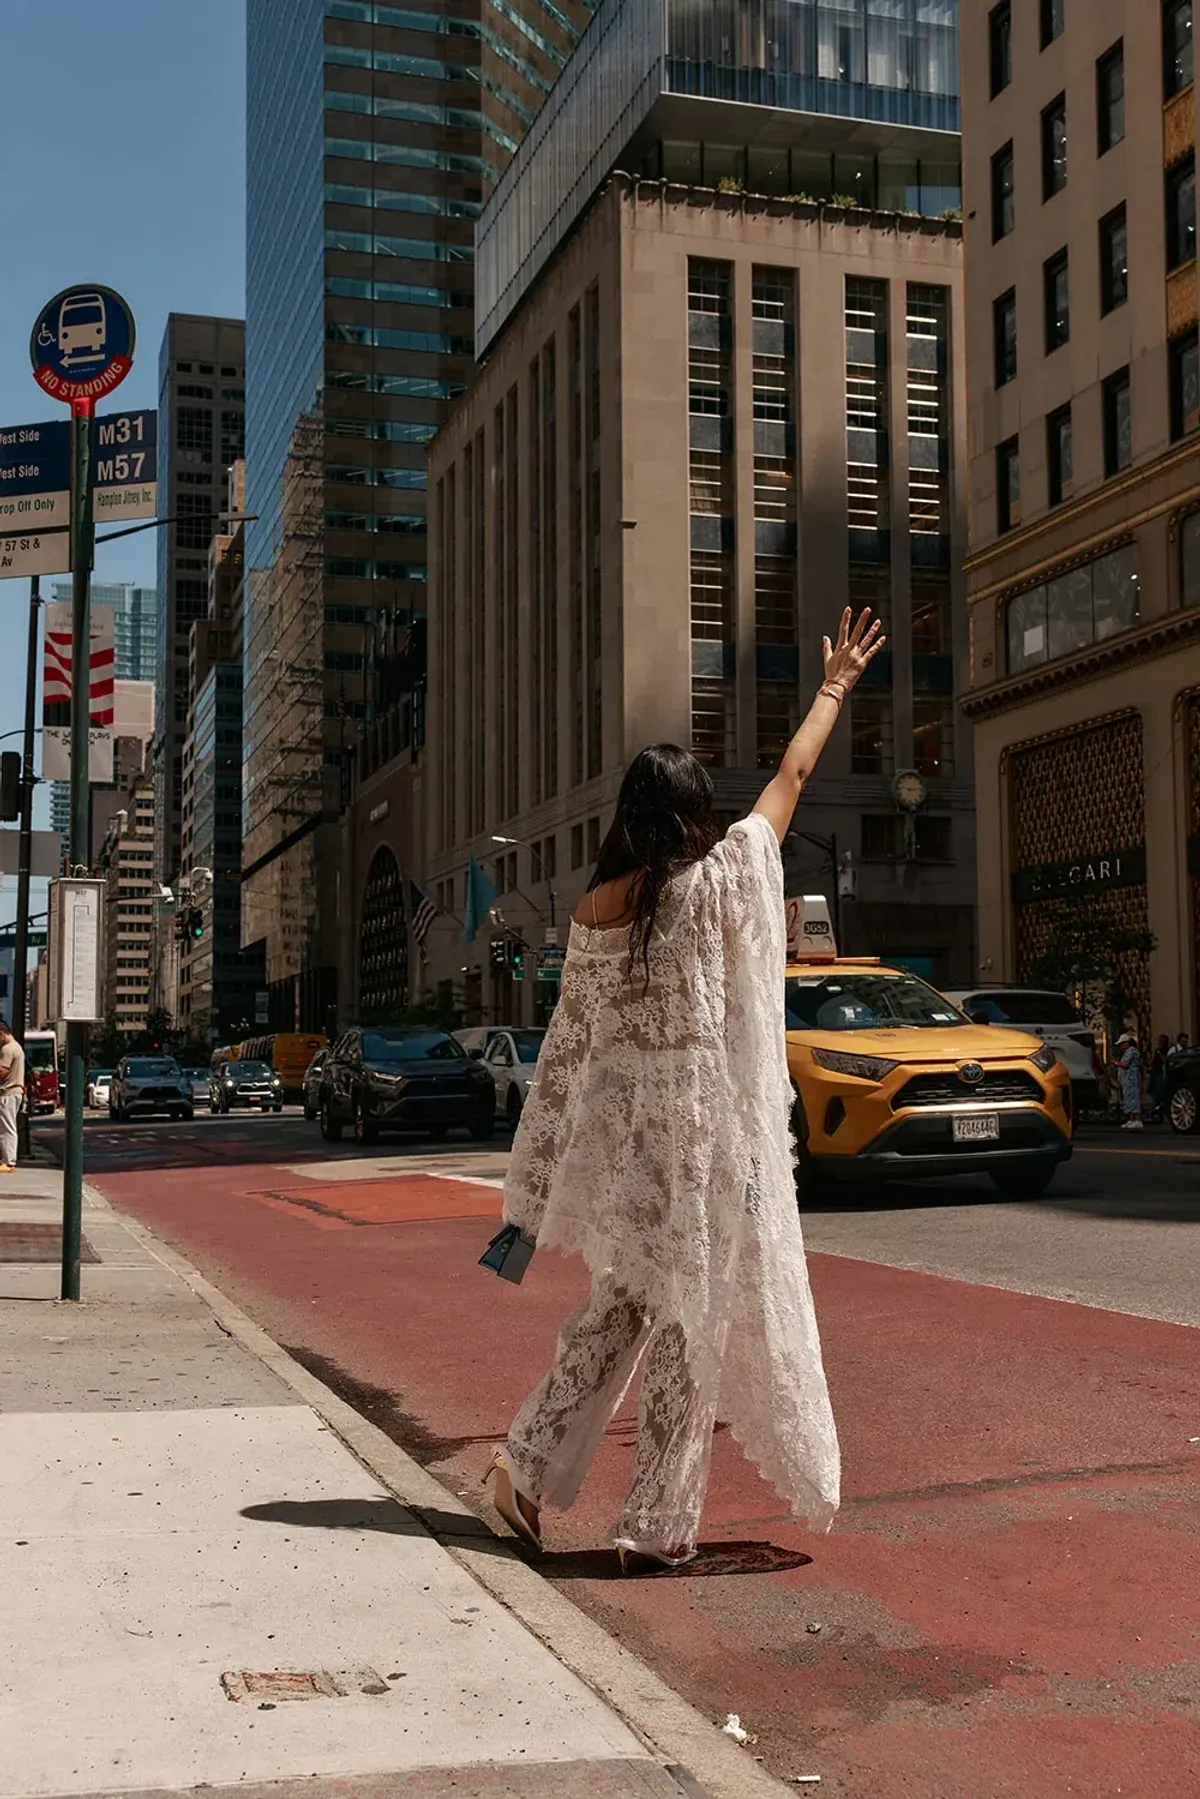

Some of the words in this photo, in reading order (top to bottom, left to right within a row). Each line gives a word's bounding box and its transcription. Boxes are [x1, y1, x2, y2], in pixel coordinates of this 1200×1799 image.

[41, 370, 59, 390] NO
[60, 362, 123, 397] STANDING
[0, 432, 16, 445] est
[19, 430, 40, 443] Side
[99, 416, 144, 445] M31
[0, 466, 16, 479] est
[18, 465, 40, 478] Side
[97, 452, 145, 481] M57
[0, 504, 15, 515] rop
[17, 500, 31, 513] Off
[34, 499, 55, 511] Only
[5, 540, 17, 552] 57
[20, 539, 30, 550] St
[33, 538, 40, 549] &
[1, 556, 13, 567] Av
